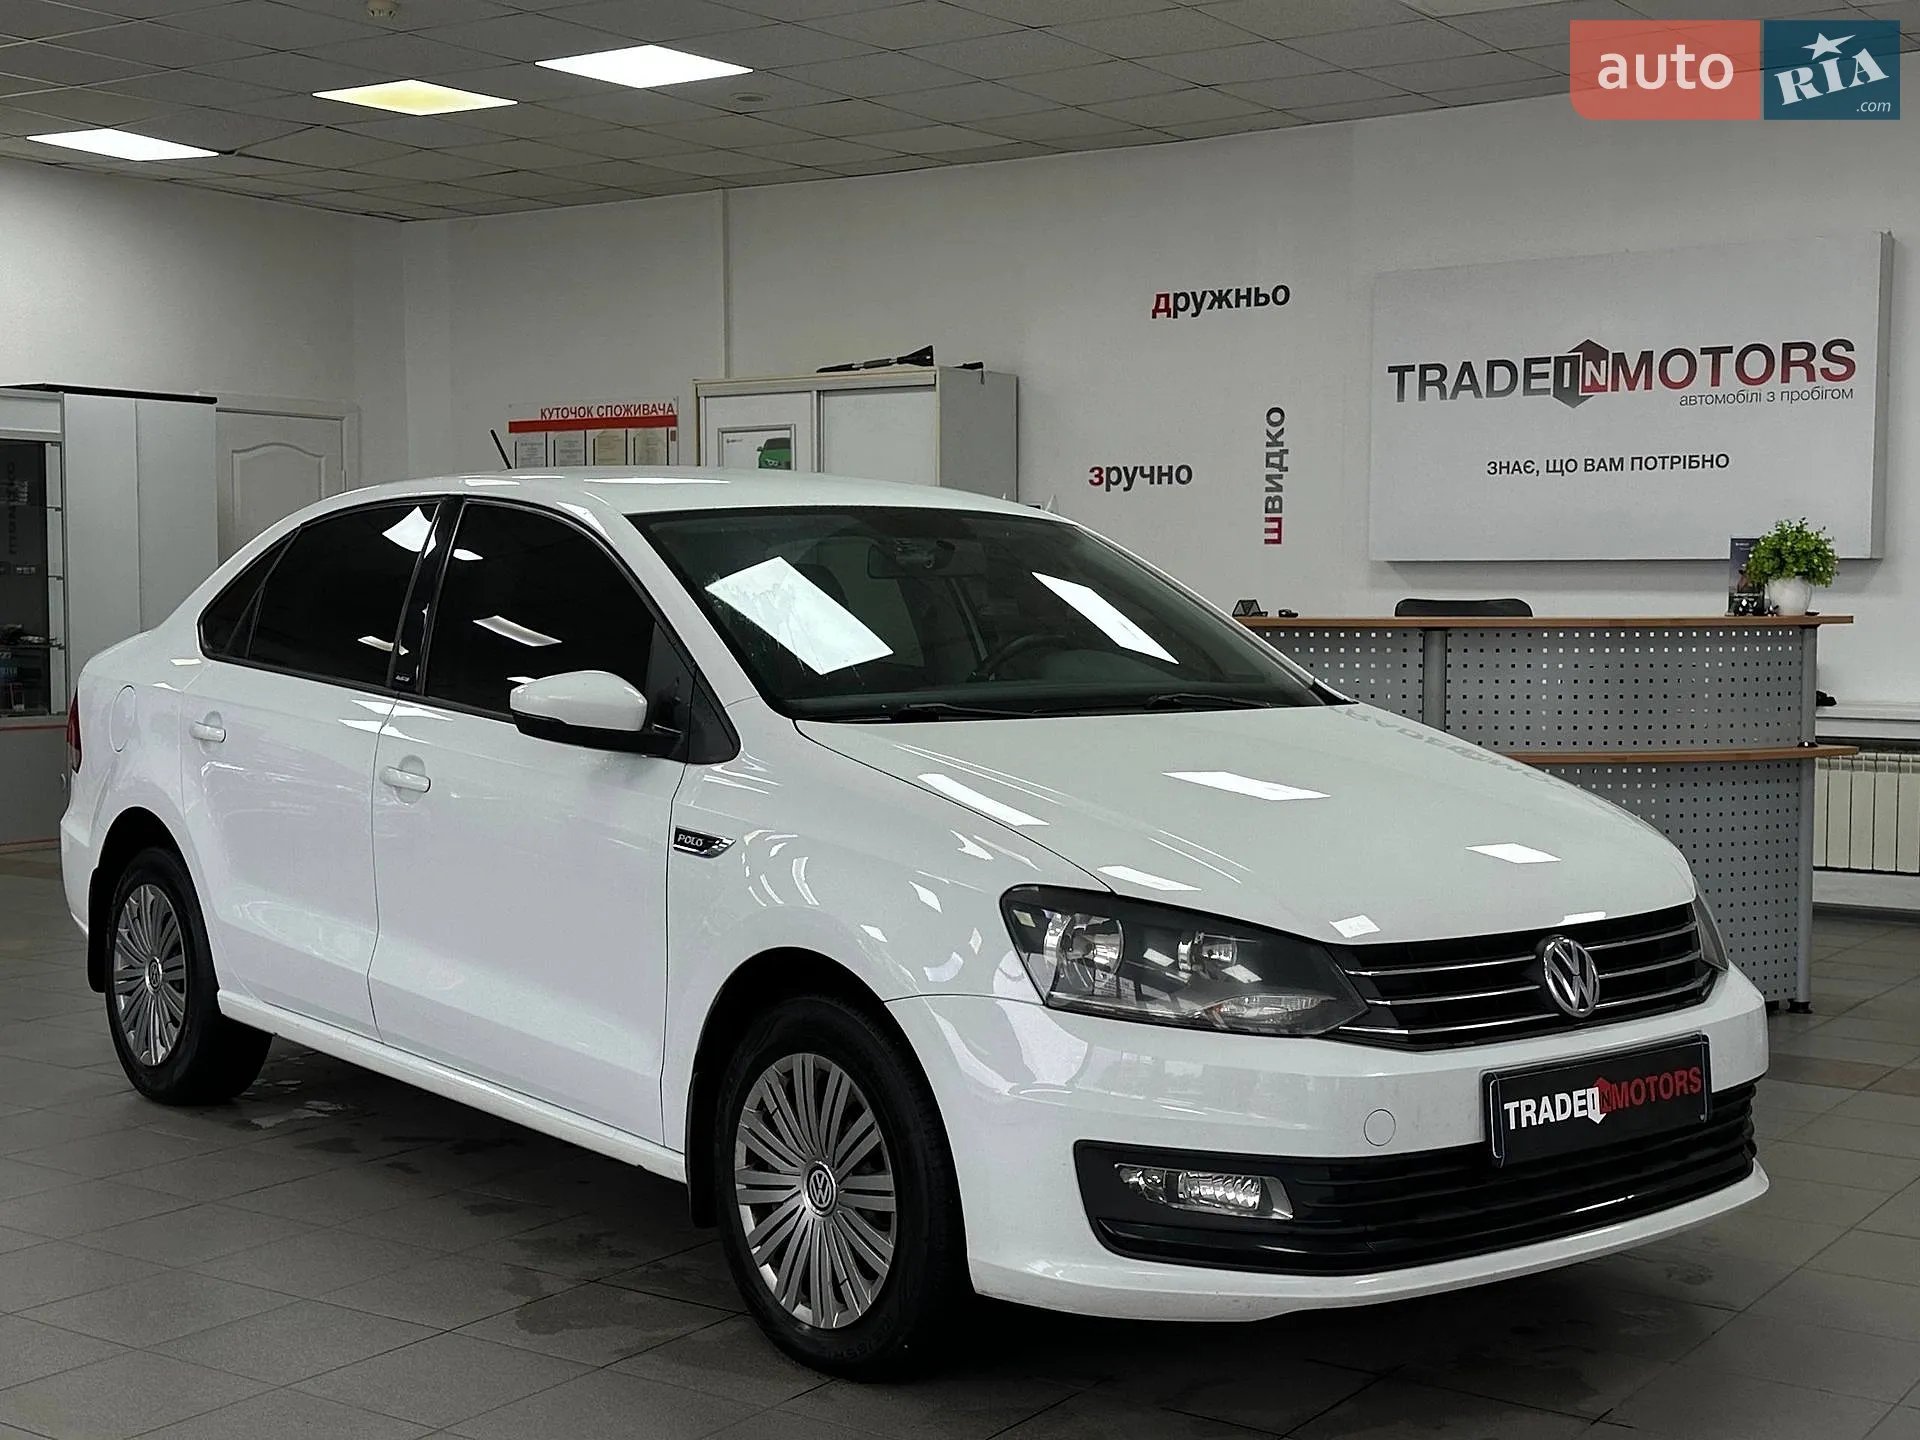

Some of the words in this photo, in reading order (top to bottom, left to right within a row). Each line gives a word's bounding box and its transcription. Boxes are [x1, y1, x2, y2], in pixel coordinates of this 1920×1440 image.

[1151, 284, 1290, 319] дружньо
[1679, 389, 1762, 406] автомобілі
[1766, 390, 1775, 403] з
[1780, 386, 1854, 404] пробігом
[540, 405, 594, 420] КУТОЧОК
[596, 402, 675, 417] СПОЖИВАЧА
[1487, 460, 1540, 477] ЗНАЄ,
[1545, 458, 1578, 477] ЩО
[1583, 456, 1625, 473] ВАМ
[1630, 453, 1730, 472] ПОТРІБНО
[1088, 464, 1193, 492] зручно
[677, 833, 703, 847] POLO
